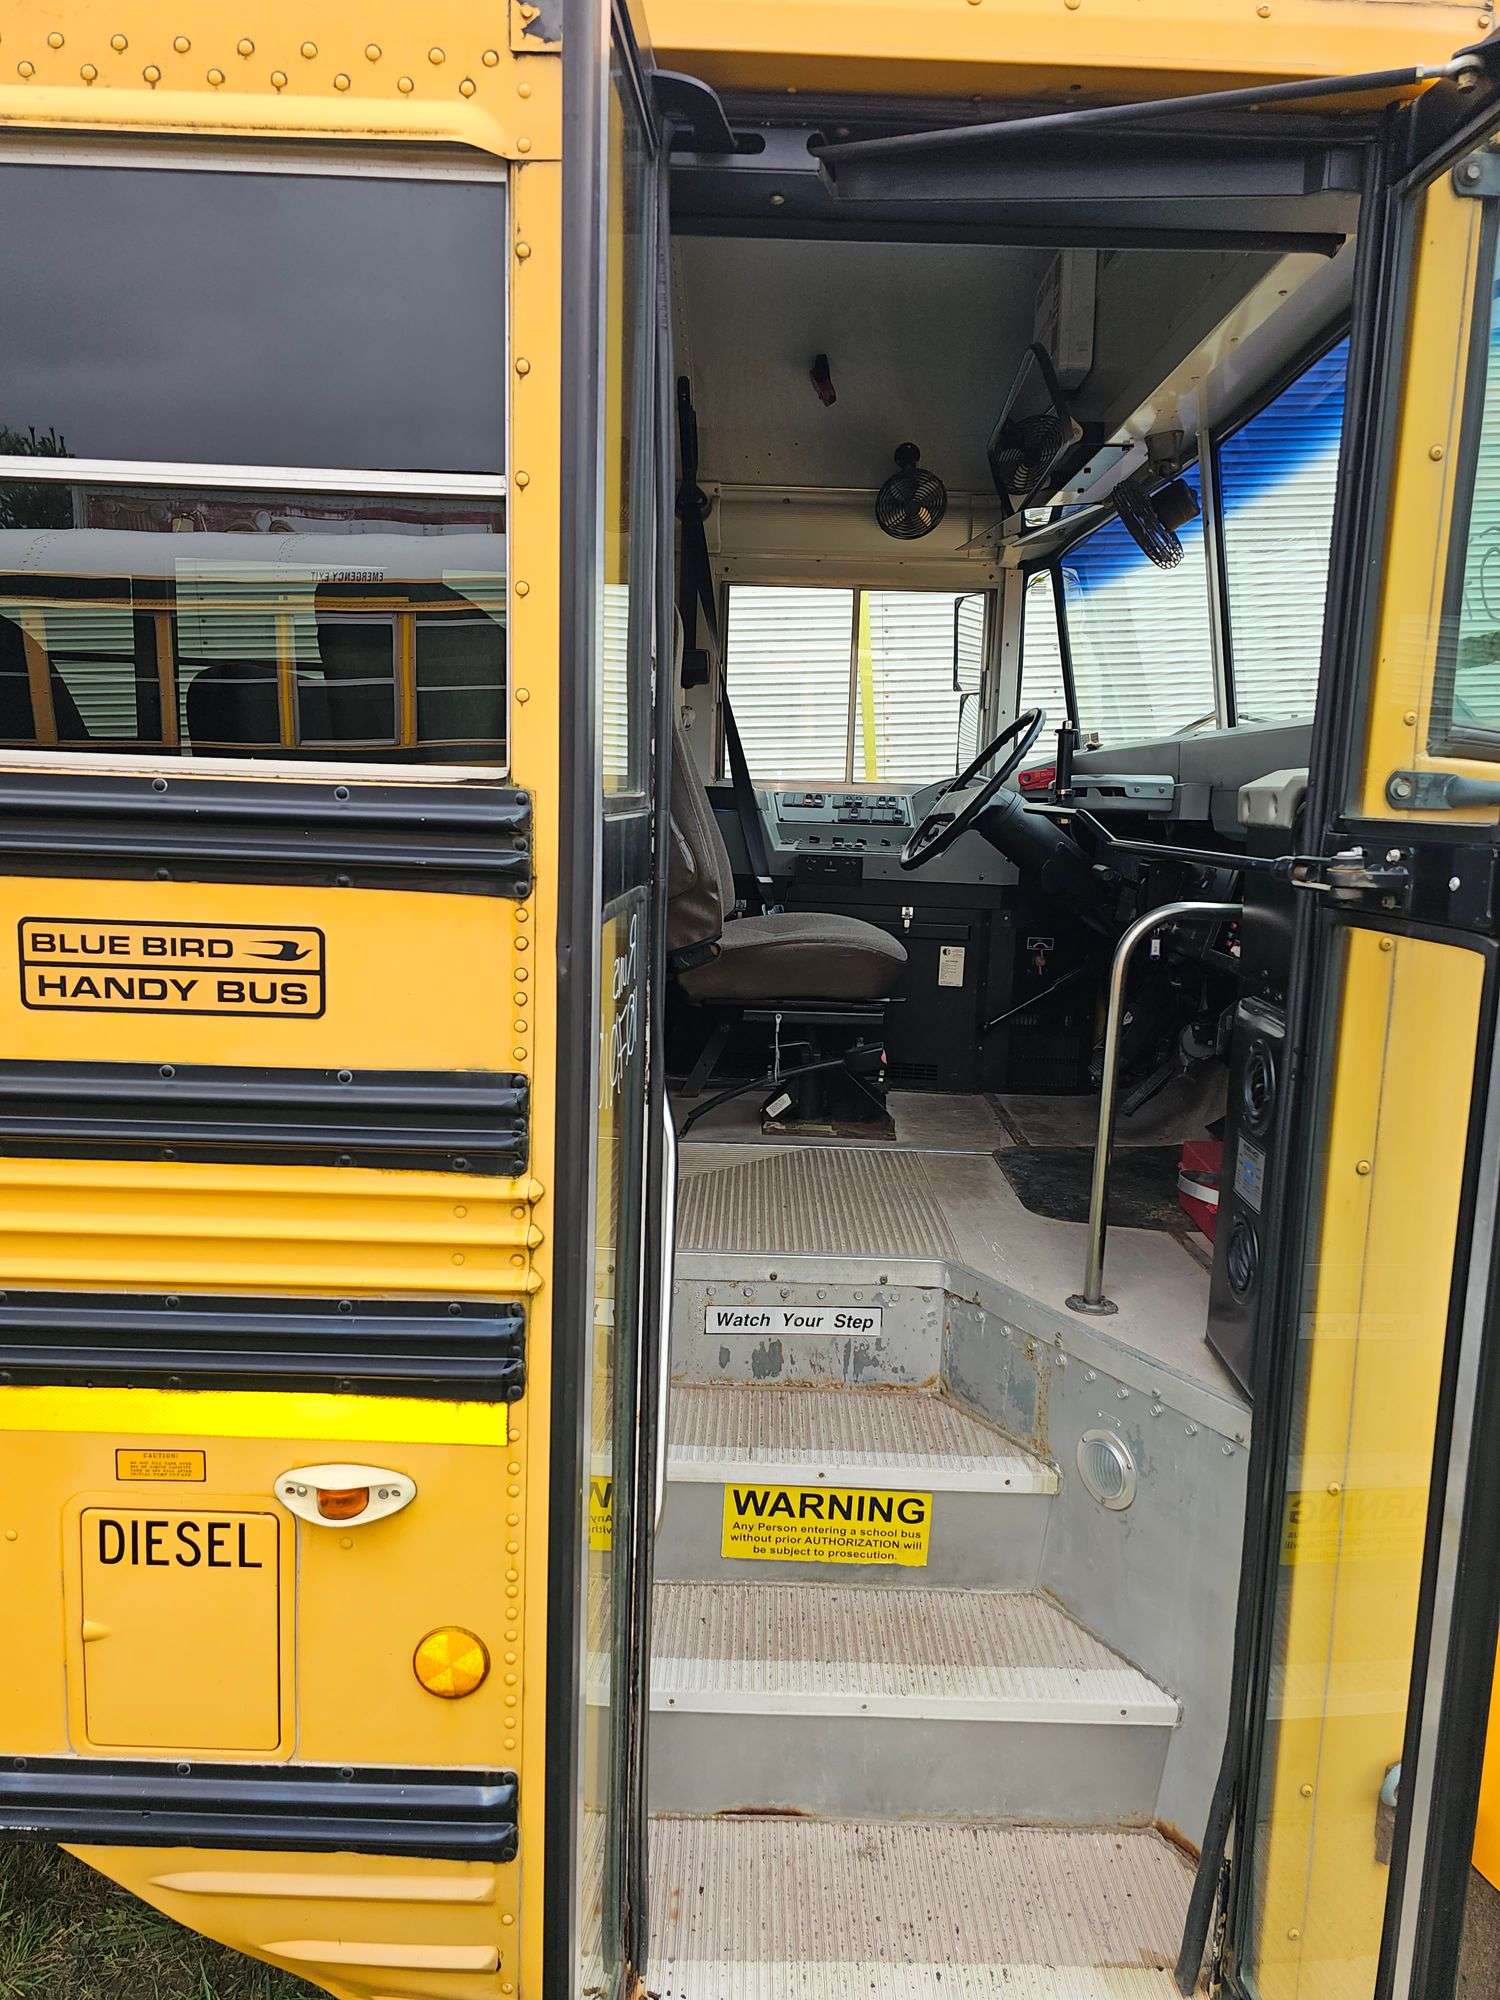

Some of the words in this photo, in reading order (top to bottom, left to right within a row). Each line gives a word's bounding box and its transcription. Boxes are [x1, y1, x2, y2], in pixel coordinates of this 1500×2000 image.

[31, 932, 131, 955] BLUE
[142, 936, 233, 959] BIRD
[37, 974, 199, 1001] HANDY
[217, 980, 308, 1005] BUS
[716, 1312, 771, 1327] Watch
[783, 1312, 824, 1328] Your
[834, 1313, 874, 1332] Step
[732, 1489, 925, 1524] WARNING
[730, 1532, 772, 1544] without
[775, 1534, 801, 1546] prior
[804, 1536, 900, 1549] AUTHORIZATION
[903, 1540, 922, 1550] will
[732, 1521, 754, 1533] Any
[758, 1522, 797, 1533] Person
[800, 1525, 847, 1537] entering
[850, 1528, 857, 1536] a
[860, 1527, 897, 1538] school
[901, 1528, 921, 1538] bus
[99, 1519, 262, 1568] DIESEL
[753, 1545, 767, 1554] be
[769, 1546, 811, 1557] subject
[814, 1548, 825, 1556] to
[828, 1549, 898, 1561] prosecution.
